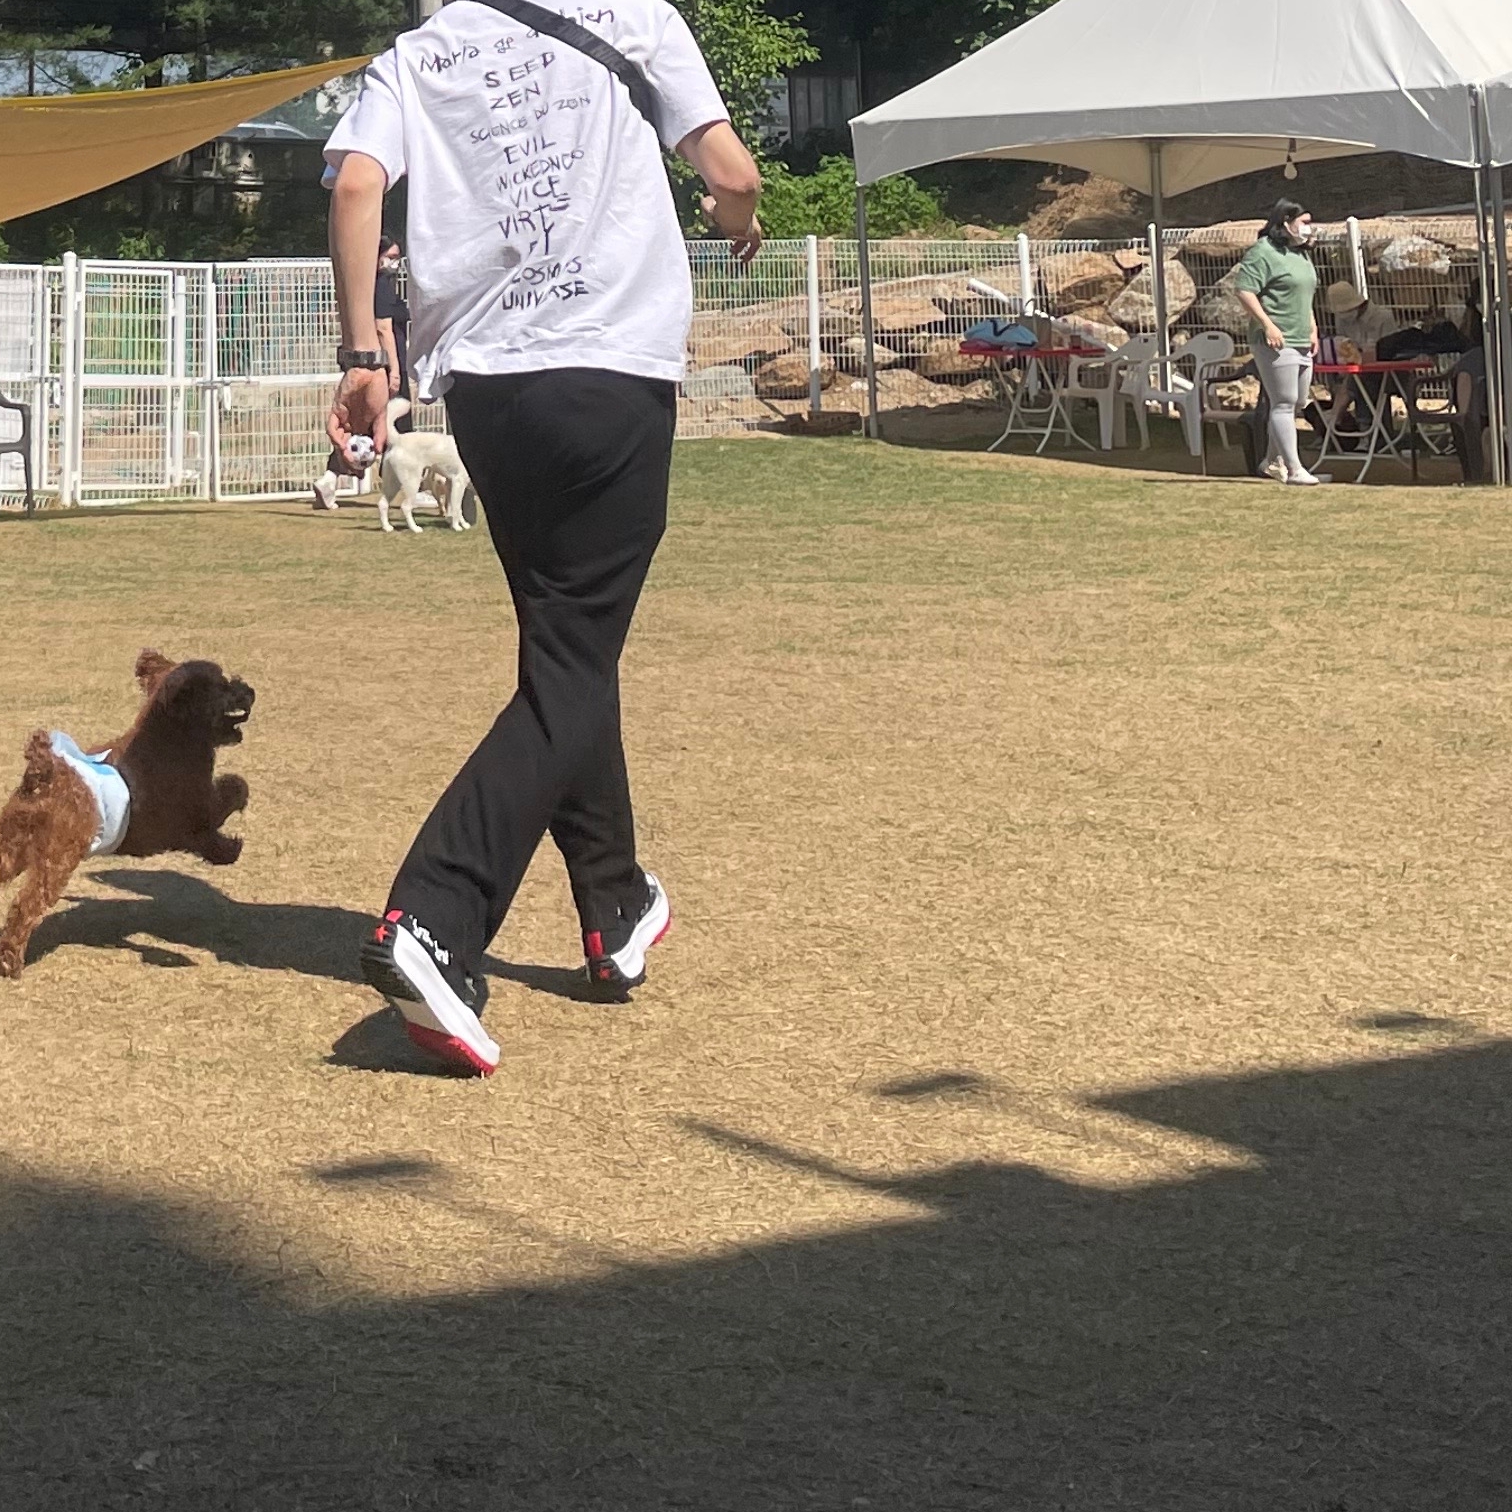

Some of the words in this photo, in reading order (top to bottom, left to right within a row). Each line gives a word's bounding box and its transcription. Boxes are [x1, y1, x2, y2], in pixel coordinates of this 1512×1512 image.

[483, 51, 556, 88] SEED
[489, 80, 541, 109] ZEN
[503, 134, 557, 164] EVIL
